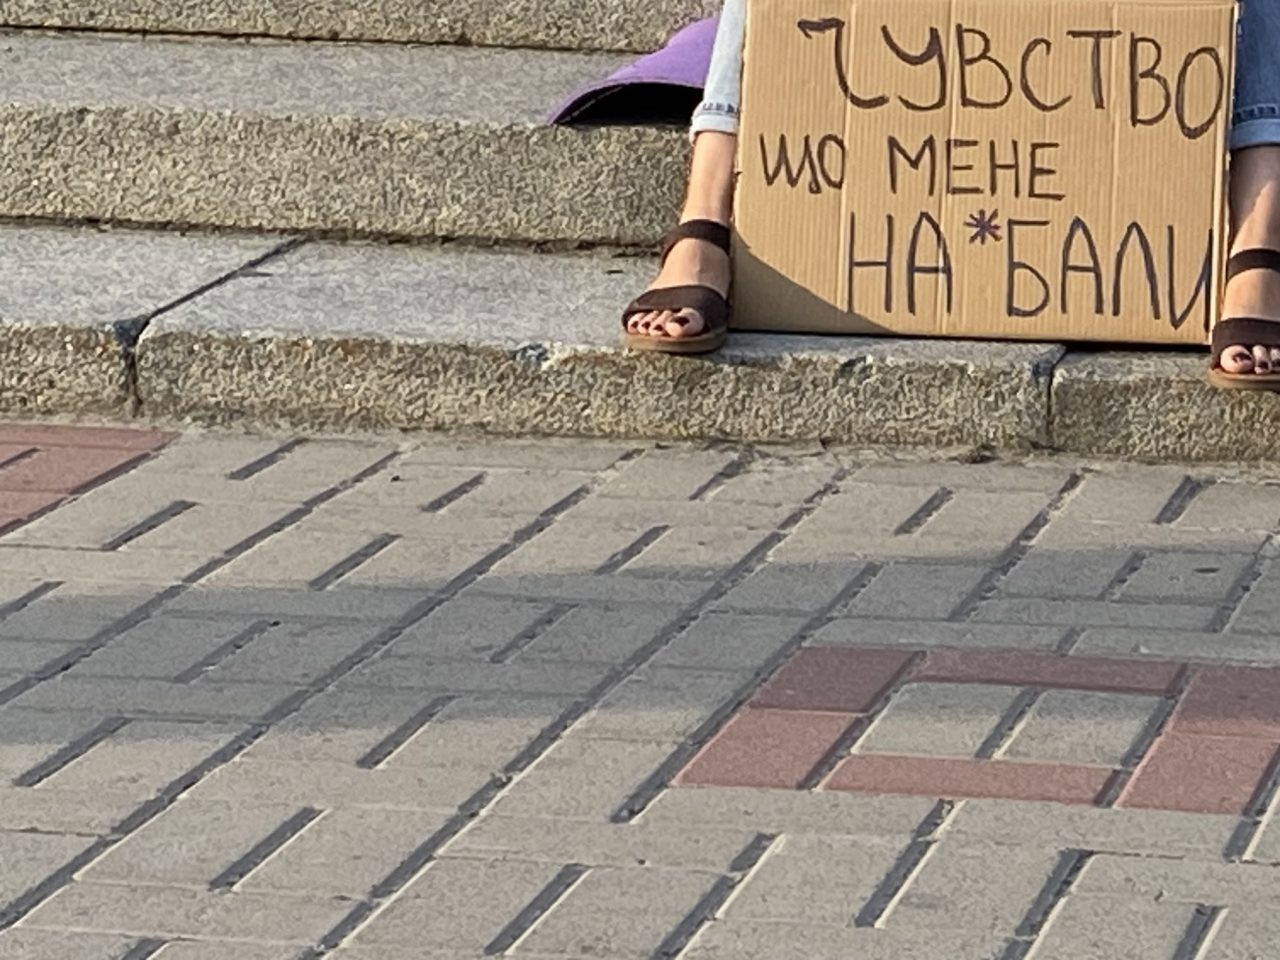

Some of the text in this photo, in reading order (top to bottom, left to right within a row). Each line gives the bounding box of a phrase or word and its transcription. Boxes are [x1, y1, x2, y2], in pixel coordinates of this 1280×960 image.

[796, 16, 1225, 140] ЧУВСТВО
[759, 132, 1066, 202] ЩО МЕНЕ
